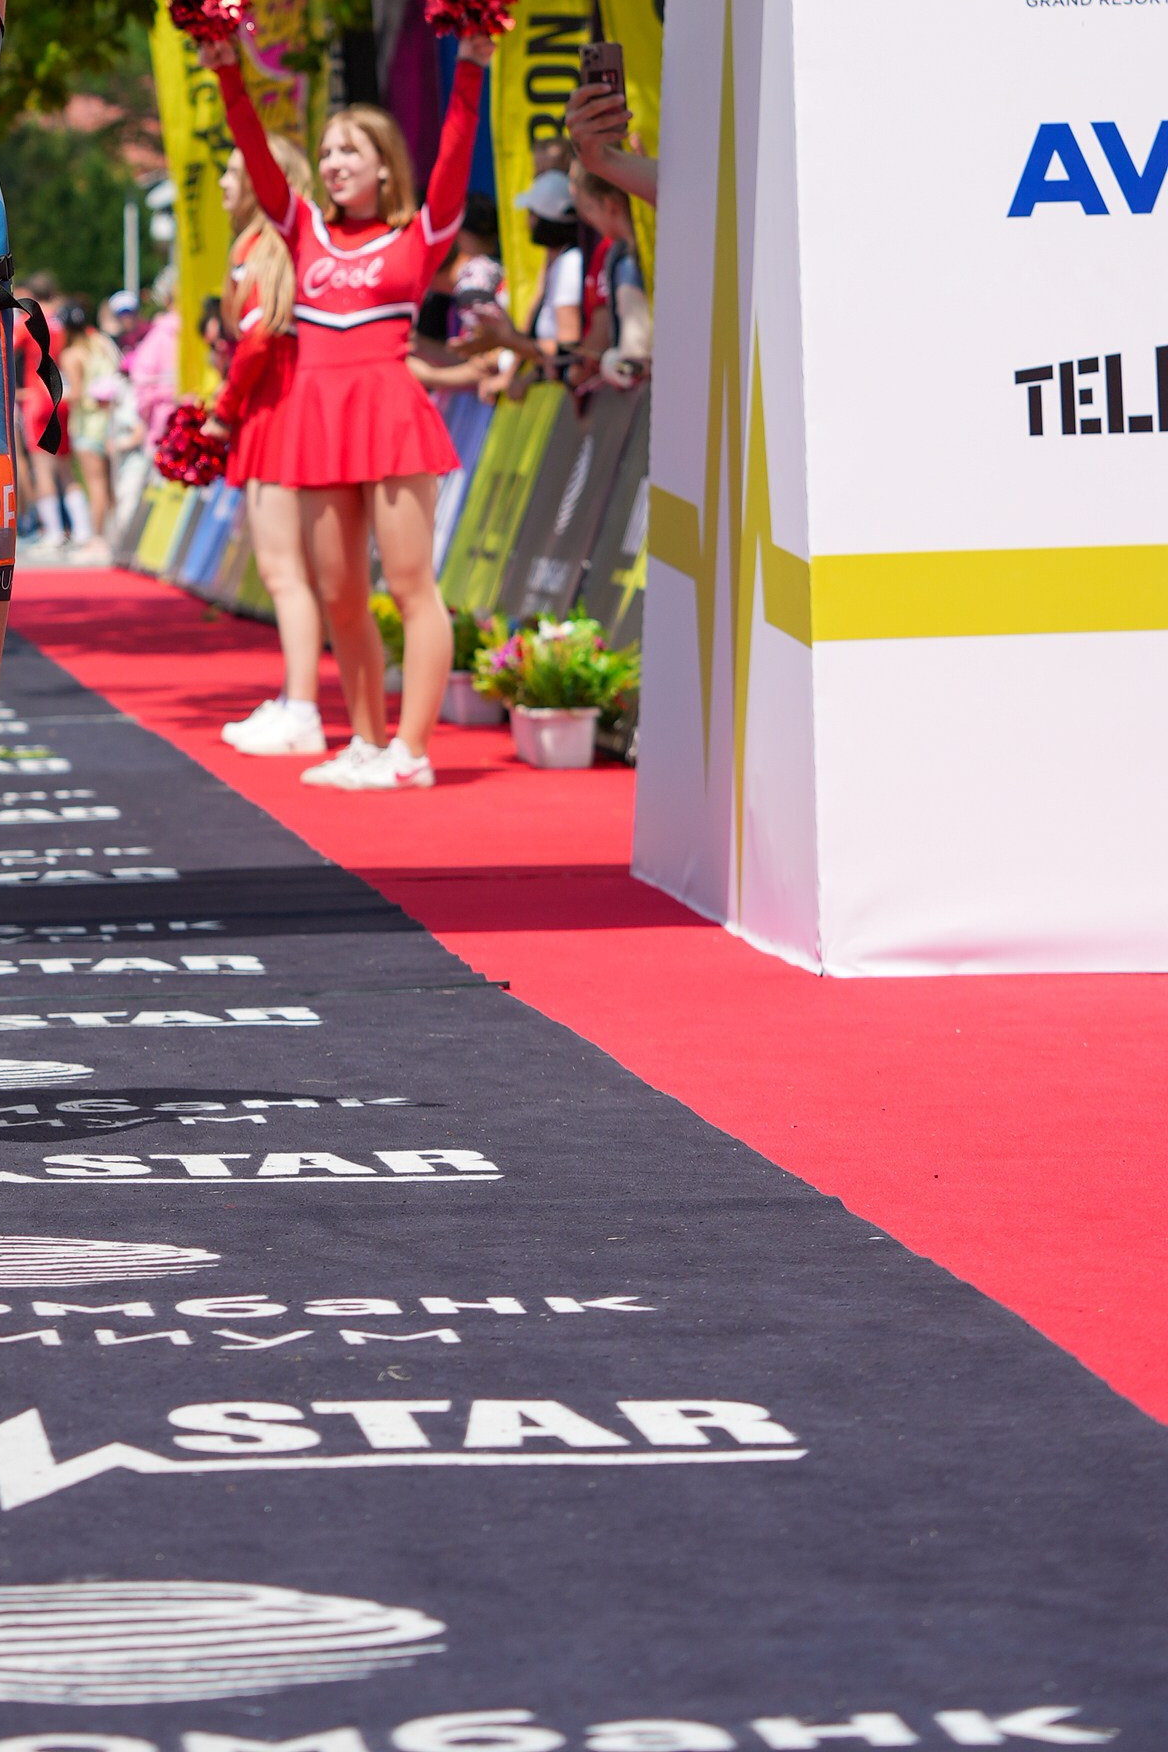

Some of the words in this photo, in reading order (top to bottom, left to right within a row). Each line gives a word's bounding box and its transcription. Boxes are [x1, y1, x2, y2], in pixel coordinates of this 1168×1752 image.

[1006, 120, 1168, 217] AV
[303, 256, 384, 299] Cool
[43, 1149, 500, 1178] STAR
[167, 1399, 799, 1454] STAR
